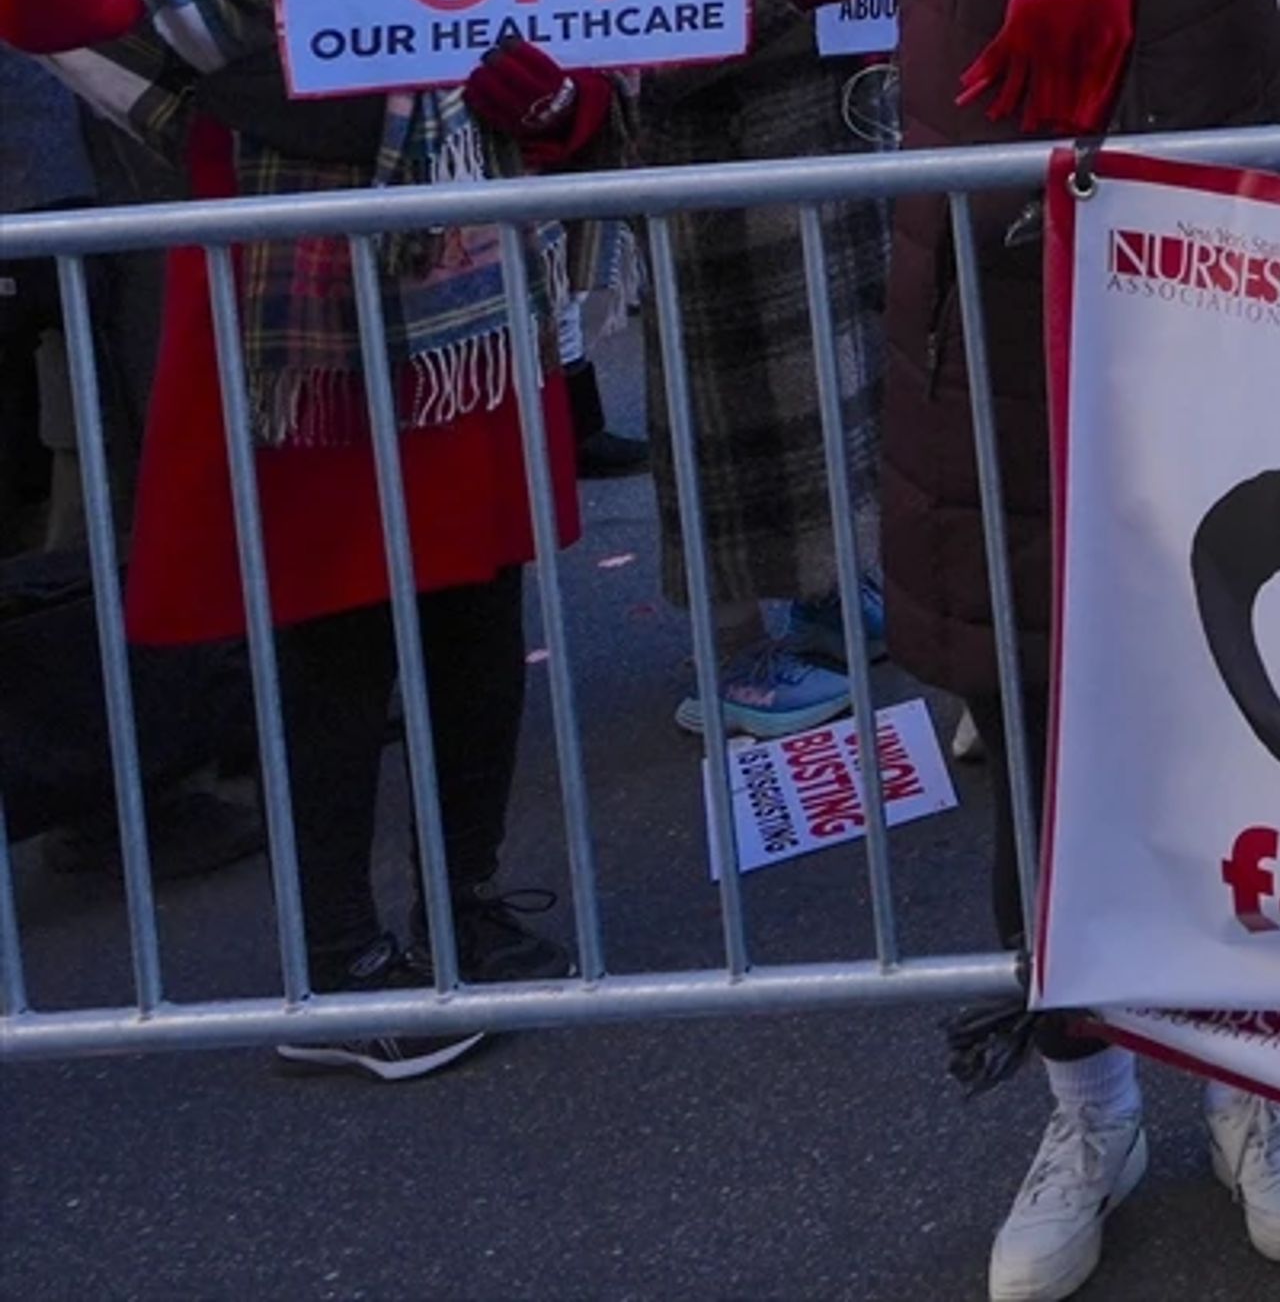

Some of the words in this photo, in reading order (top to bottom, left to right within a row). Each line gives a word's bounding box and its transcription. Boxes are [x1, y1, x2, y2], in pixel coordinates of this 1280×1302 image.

[310, 23, 416, 60] OUR
[431, 1, 726, 50] HEALTHCARE
[781, 730, 866, 838] BUSTING
